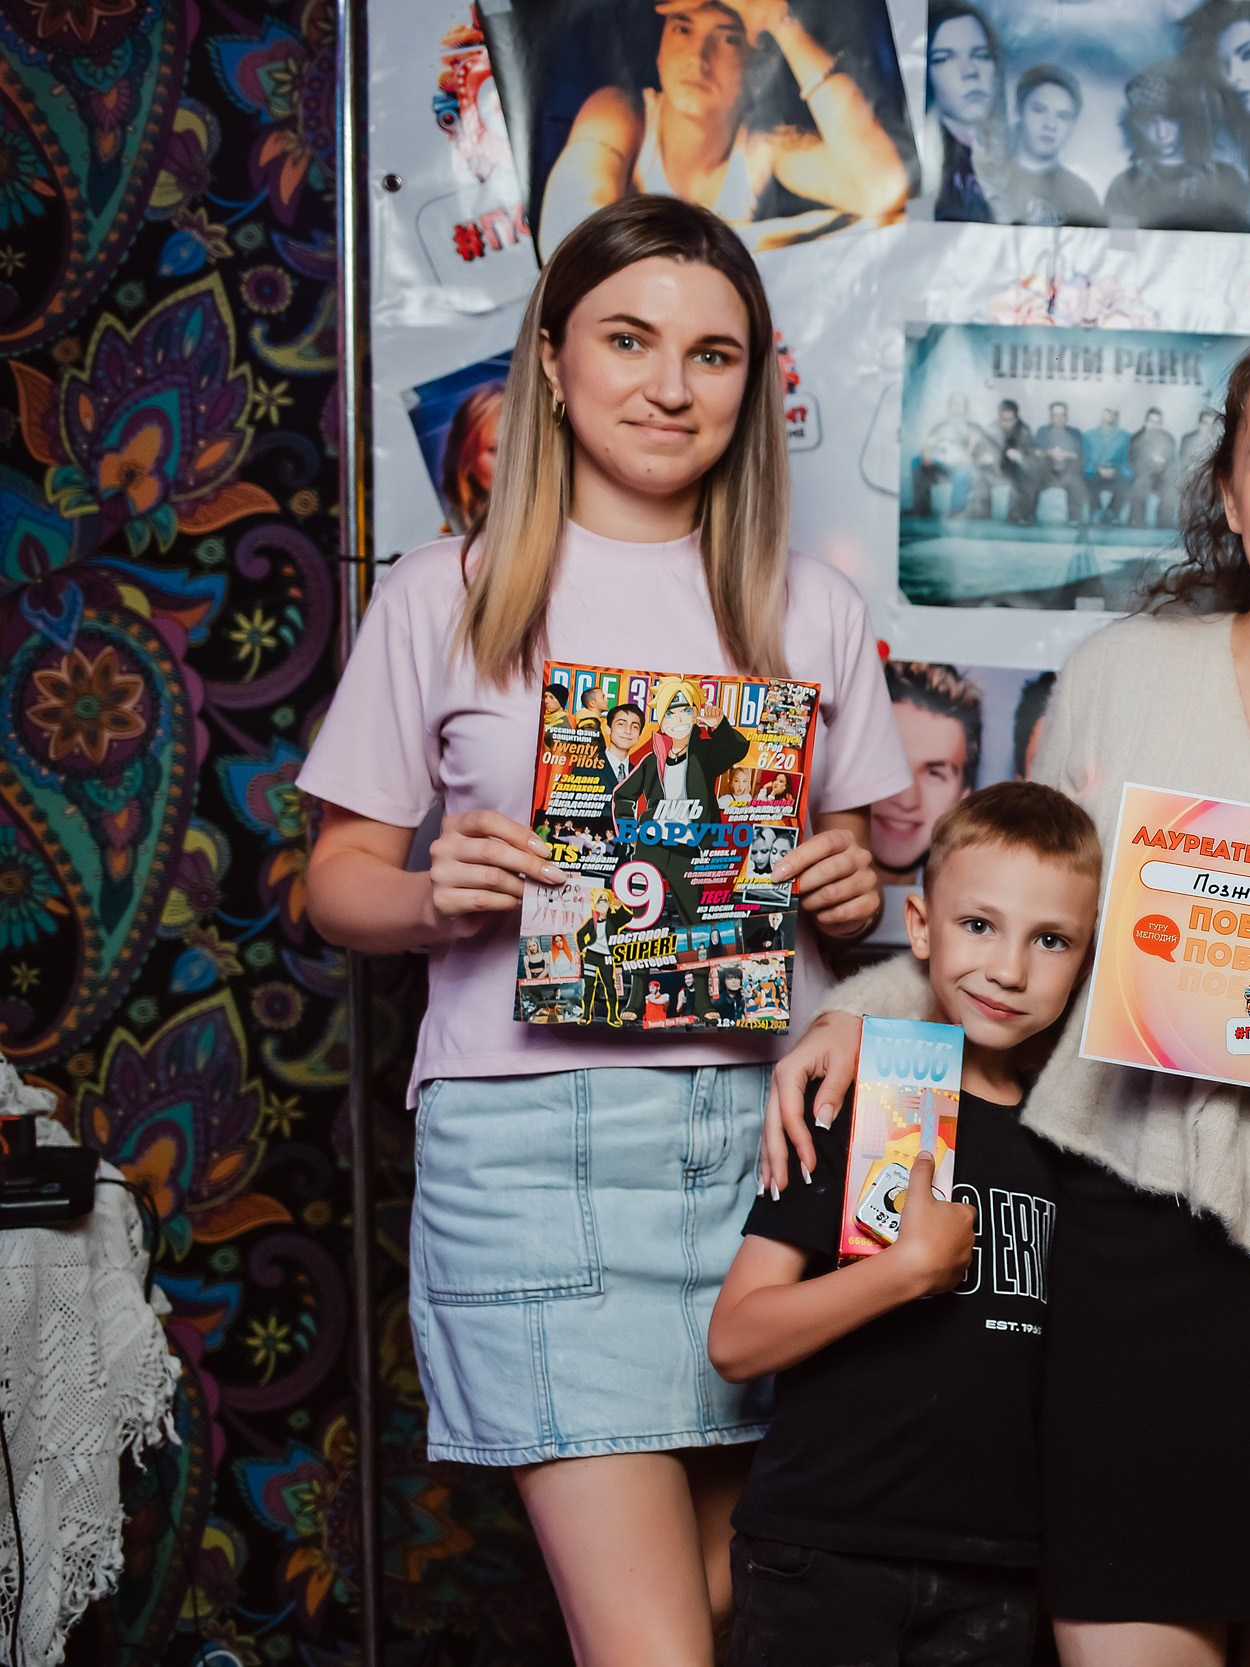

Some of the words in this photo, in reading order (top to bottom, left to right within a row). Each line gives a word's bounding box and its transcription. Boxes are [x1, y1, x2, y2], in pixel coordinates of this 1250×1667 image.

[993, 342, 1103, 381] LINKIN
[1115, 346, 1202, 386] PARK
[552, 740, 599, 757] Twenty
[542, 752, 567, 766] One
[569, 755, 605, 770] Pilots
[757, 752, 796, 770] 6/20
[652, 799, 704, 820] ПУТЬ
[613, 818, 755, 848] БОРУТО
[612, 860, 665, 930] 9
[1148, 922, 1169, 931] ГУРУ
[608, 927, 670, 946] постеров
[1135, 929, 1178, 943] МЕЛОДИЙ
[613, 934, 678, 965] SUPER!
[622, 955, 677, 971] постеров
[985, 1319, 1020, 1332] EST.
